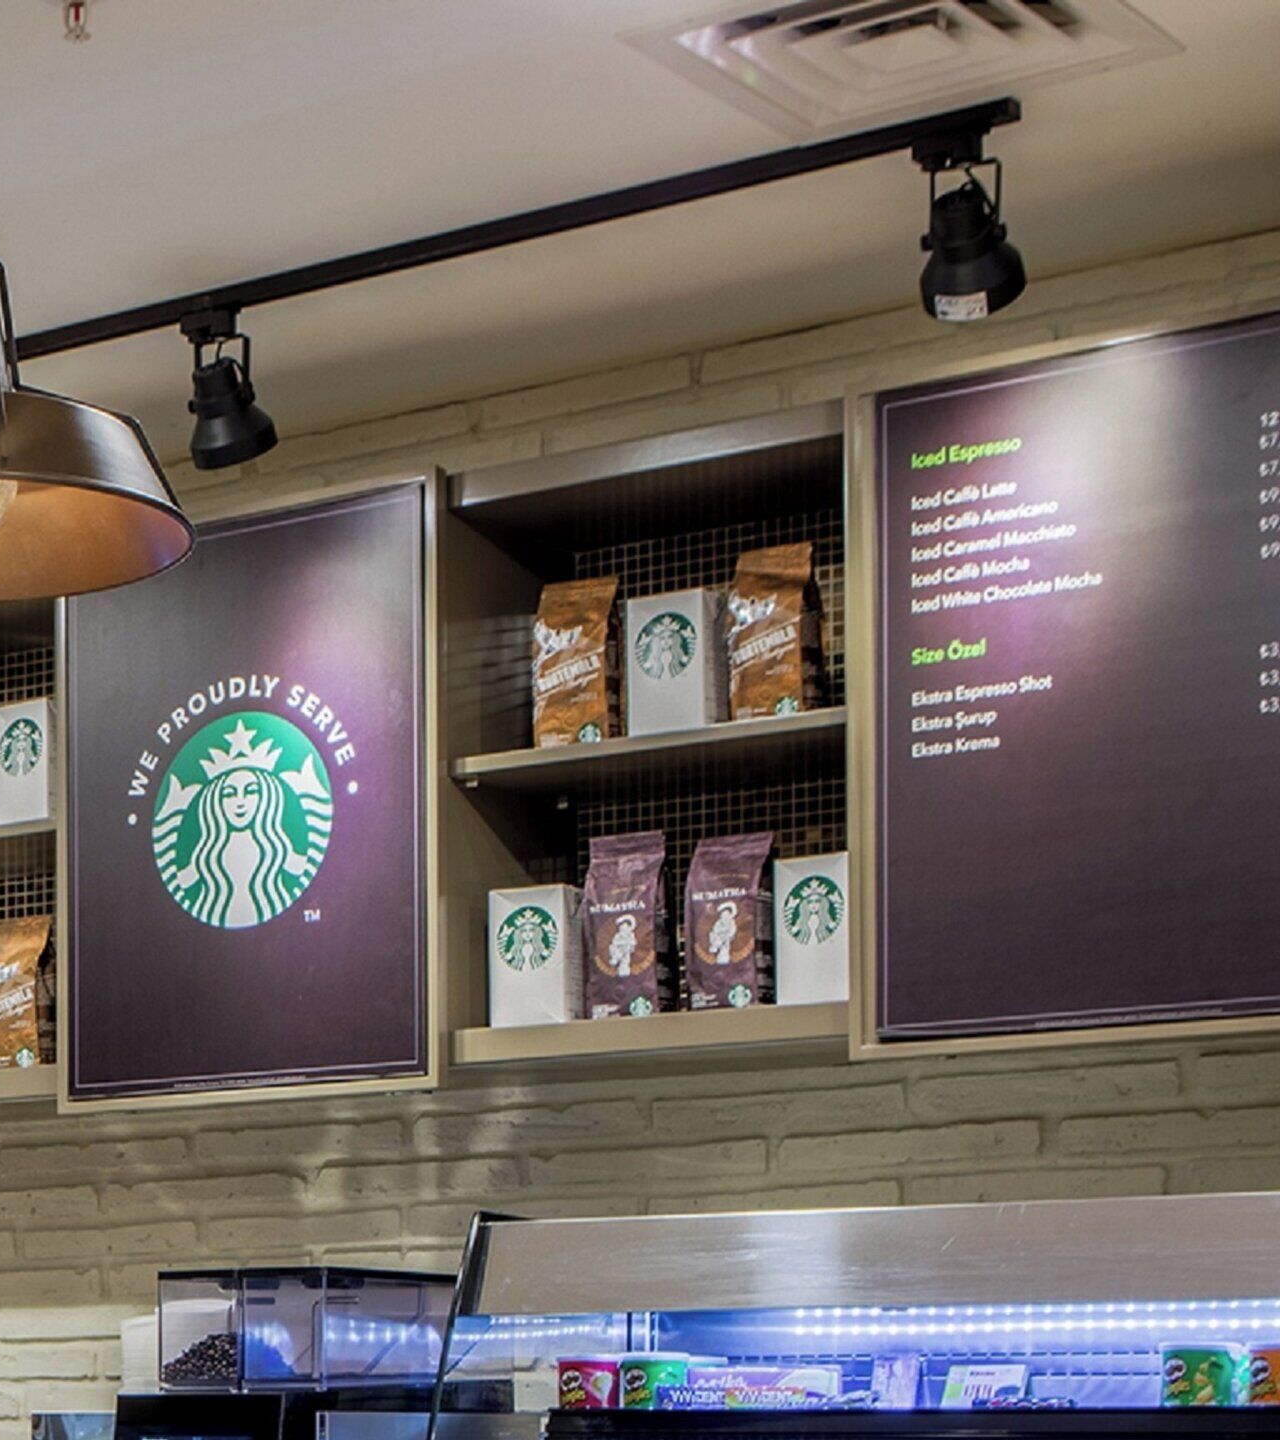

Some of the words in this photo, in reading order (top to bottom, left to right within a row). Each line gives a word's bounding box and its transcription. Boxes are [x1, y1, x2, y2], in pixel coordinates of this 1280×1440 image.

[911, 447, 946, 470] Iced
[948, 437, 1022, 464] Espresso
[911, 494, 941, 511] Iced
[982, 480, 1018, 498] Latte
[911, 519, 941, 537] Iced
[981, 500, 1058, 525] Americano
[911, 545, 941, 563] Iced
[944, 535, 1001, 558] Caramel
[1003, 523, 1077, 549] Macchiato
[911, 570, 941, 588] Iced
[982, 557, 1030, 577] Mocha
[911, 596, 940, 614] Iced
[941, 588, 981, 609] White
[983, 579, 1053, 604] Chocolate
[1054, 571, 1103, 592] Mocha
[911, 647, 945, 667] Size
[947, 638, 988, 660] Özel
[911, 690, 953, 708] Ekstra
[955, 681, 1017, 703] Espresso
[1019, 674, 1053, 693] Shot
[128, 750, 160, 797] WE
[157, 674, 280, 744] PROUDLY
[286, 684, 356, 767] SERVE
[911, 716, 953, 733] Ekstra
[911, 741, 953, 758] Ekstra
[954, 734, 1001, 753] Krema
